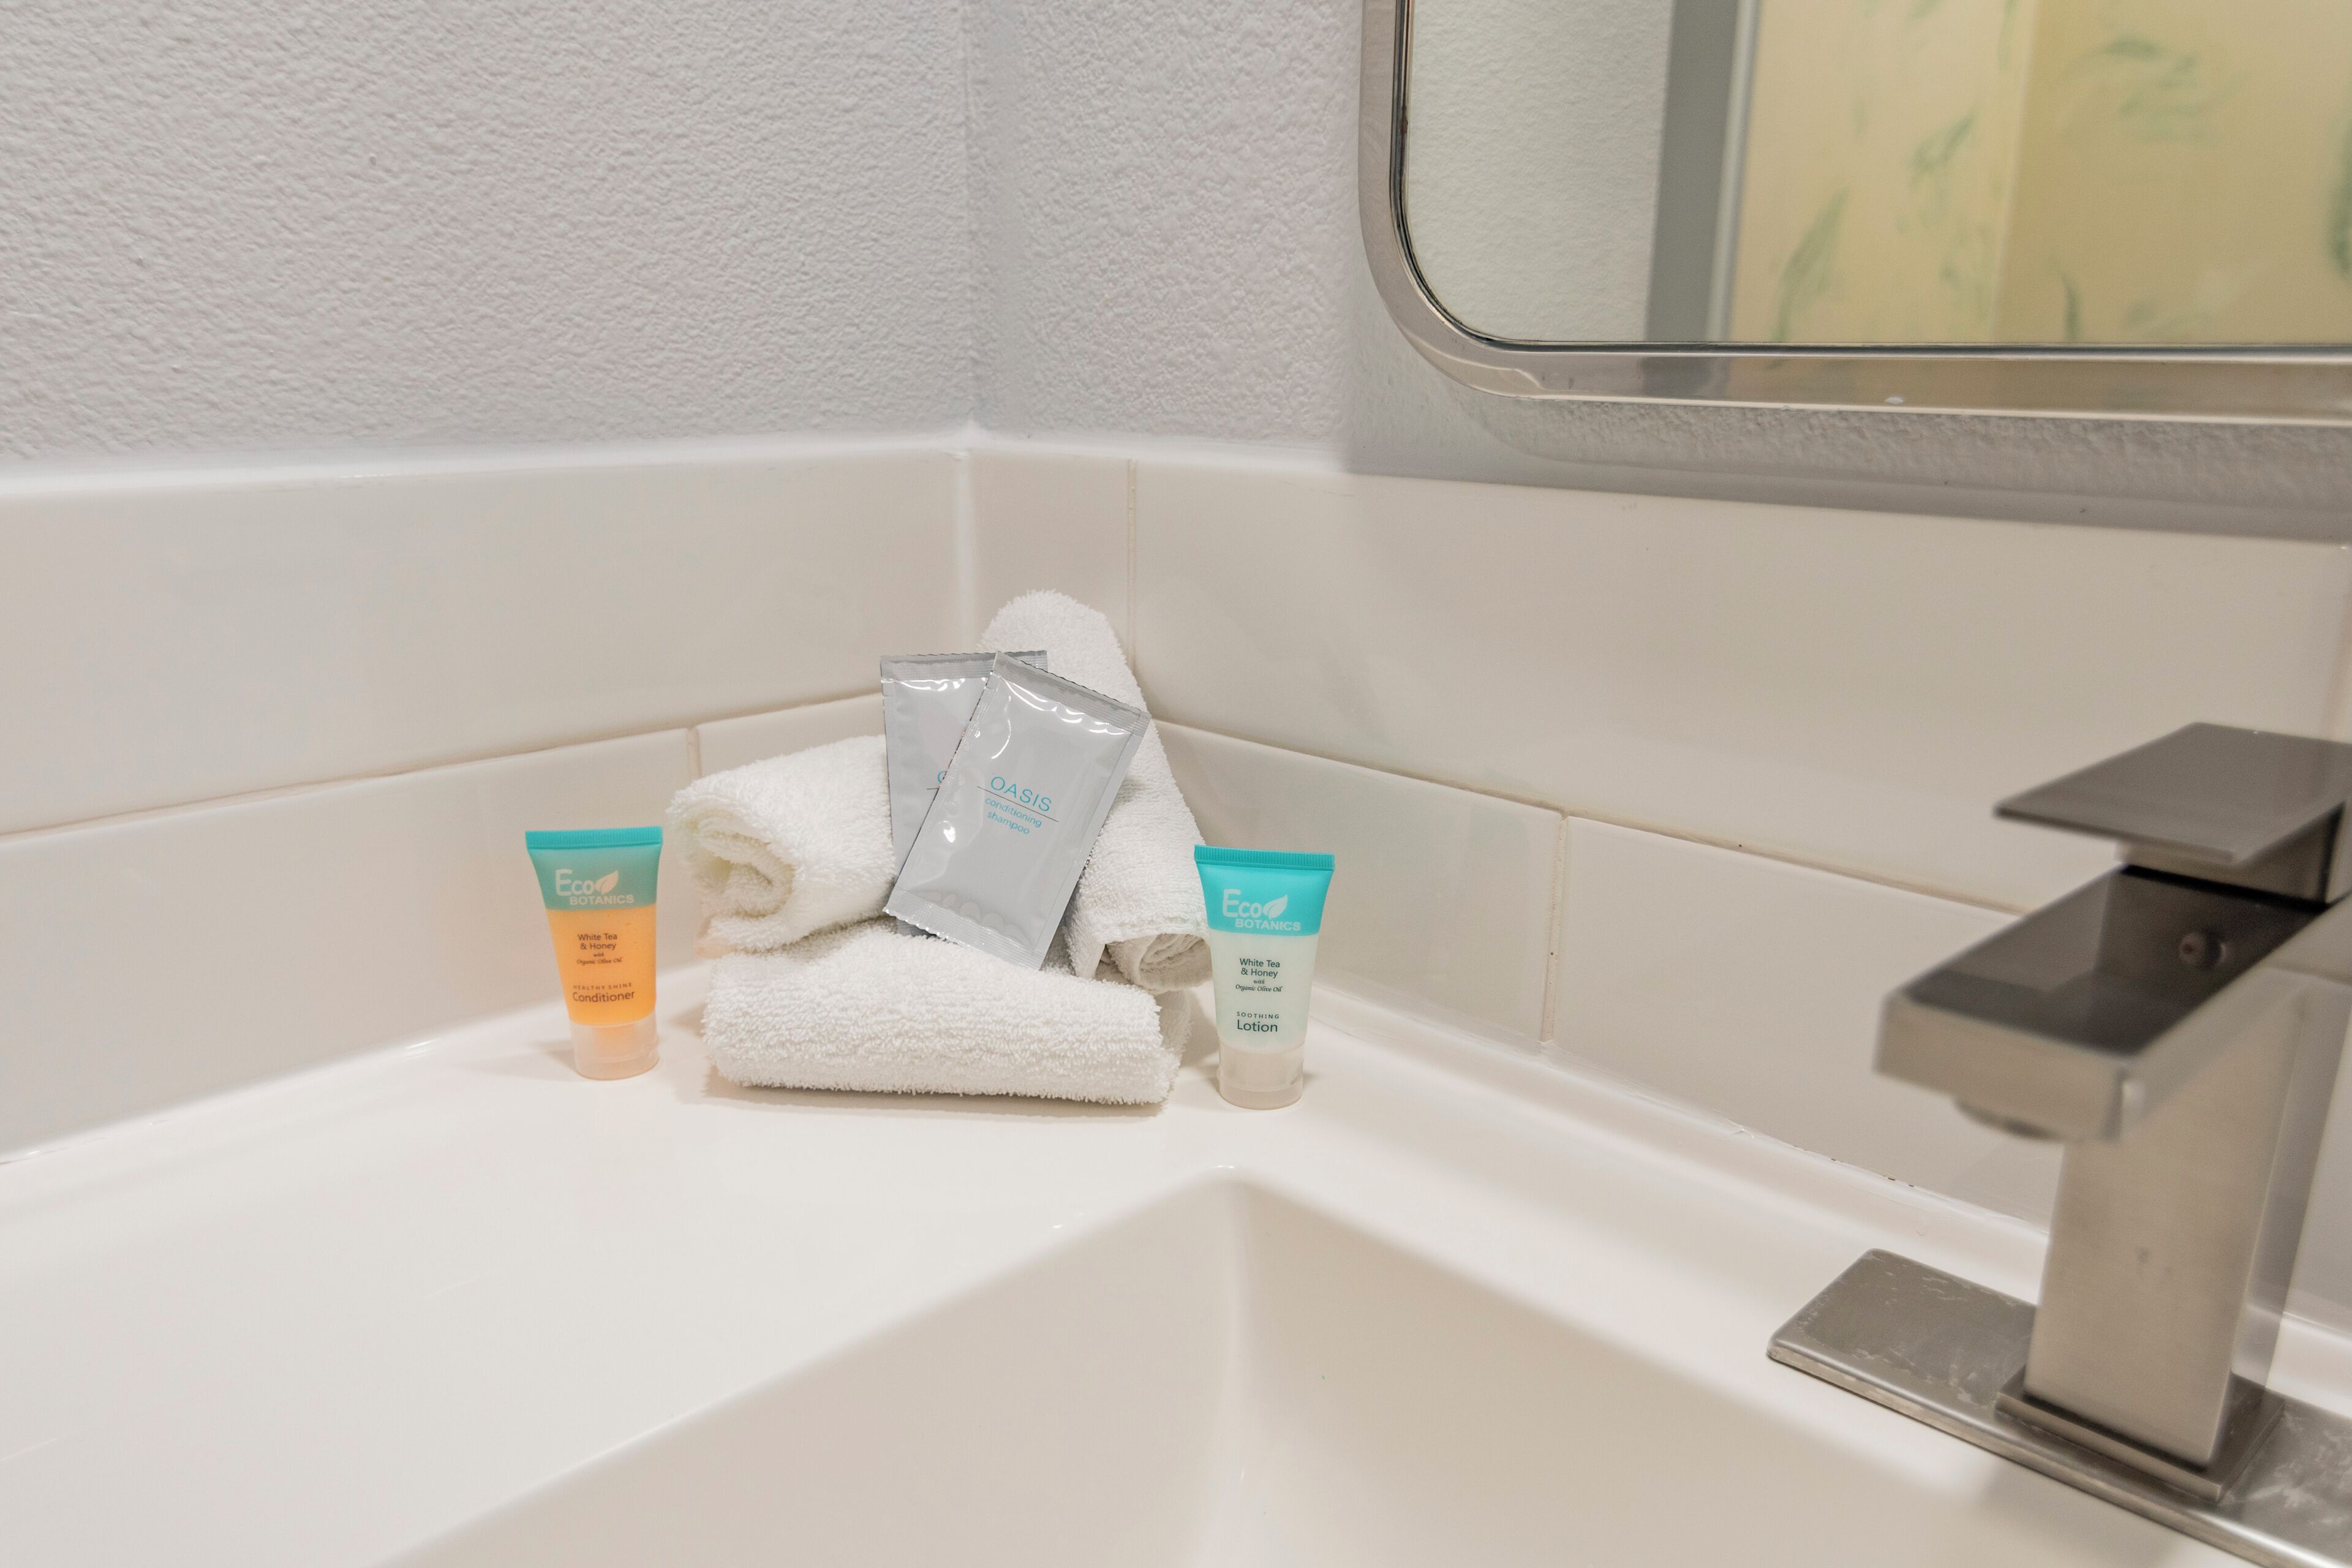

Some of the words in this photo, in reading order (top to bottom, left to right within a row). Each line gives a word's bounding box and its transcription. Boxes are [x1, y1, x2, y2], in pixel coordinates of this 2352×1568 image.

[990, 776, 1052, 812] OASIS
[985, 797, 1042, 828] conditioning
[987, 812, 1030, 834] shampoo
[569, 894, 635, 905] BOTANICS
[1235, 918, 1302, 931] BOTANICS
[1240, 958, 1264, 967] White
[1251, 968, 1278, 979] Honey
[573, 991, 635, 1003] Conditioner
[1237, 1019, 1278, 1032] Lotion
